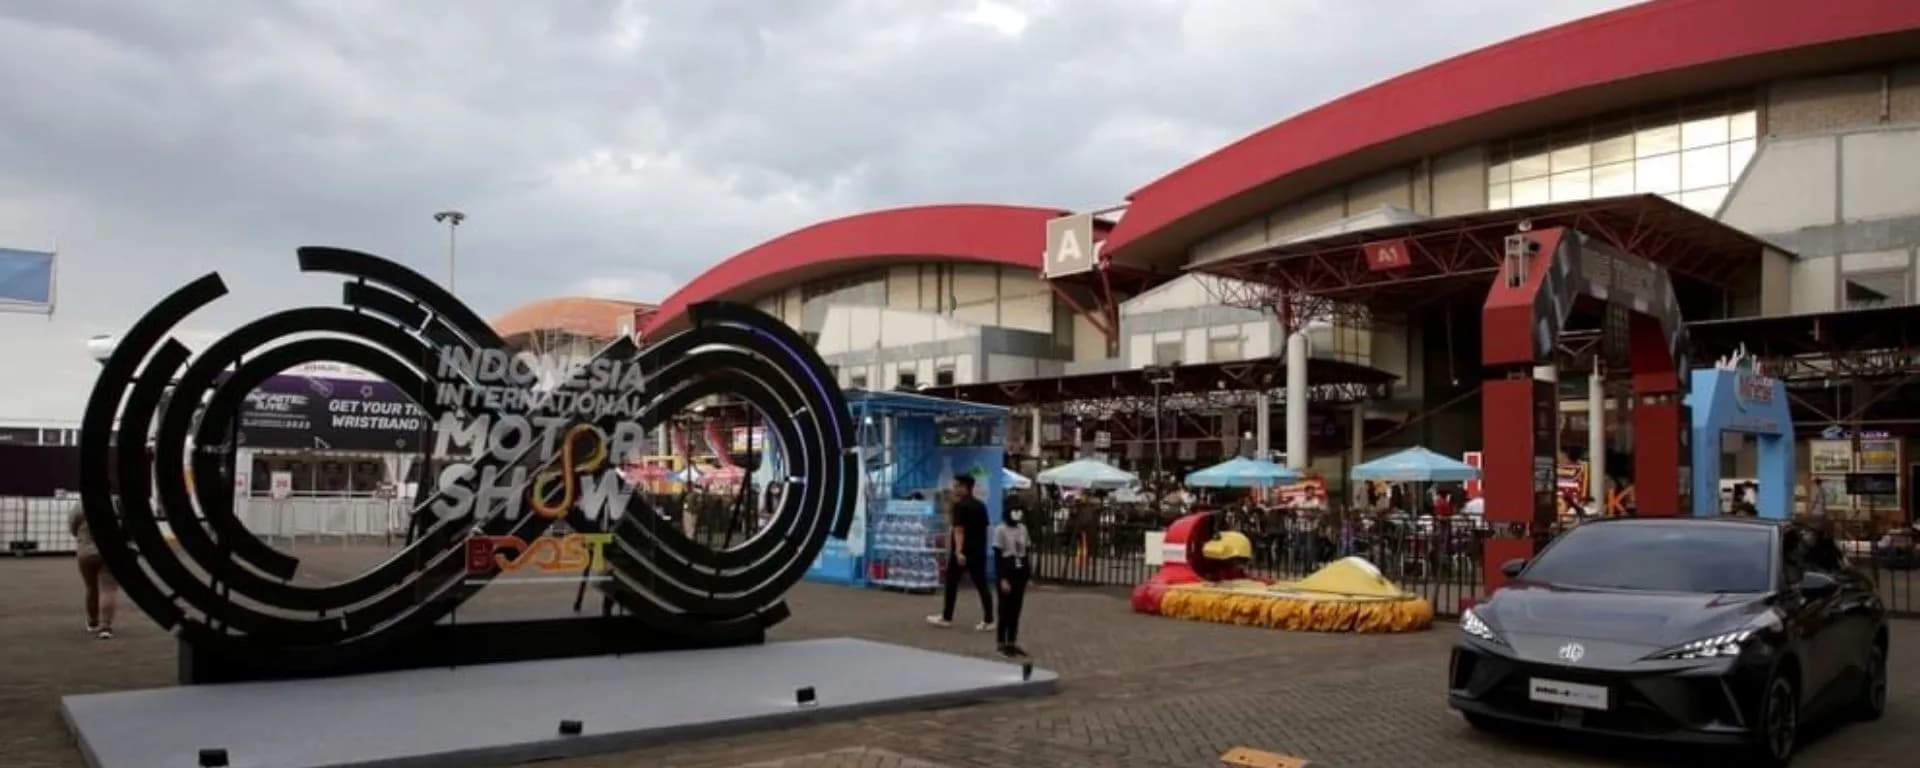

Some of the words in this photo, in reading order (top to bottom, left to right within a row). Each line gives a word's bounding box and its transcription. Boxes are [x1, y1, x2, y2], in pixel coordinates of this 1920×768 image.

[1057, 229, 1083, 262] A
[437, 346, 647, 393] INDONESIA
[328, 400, 362, 413] GET
[362, 401, 402, 415] YOUR
[436, 383, 648, 417] INTERNATIONAL
[331, 415, 420, 431] WRISTBAND
[434, 411, 646, 464] MOTOR
[431, 462, 633, 521] SHOW
[465, 532, 616, 576] BOOST
